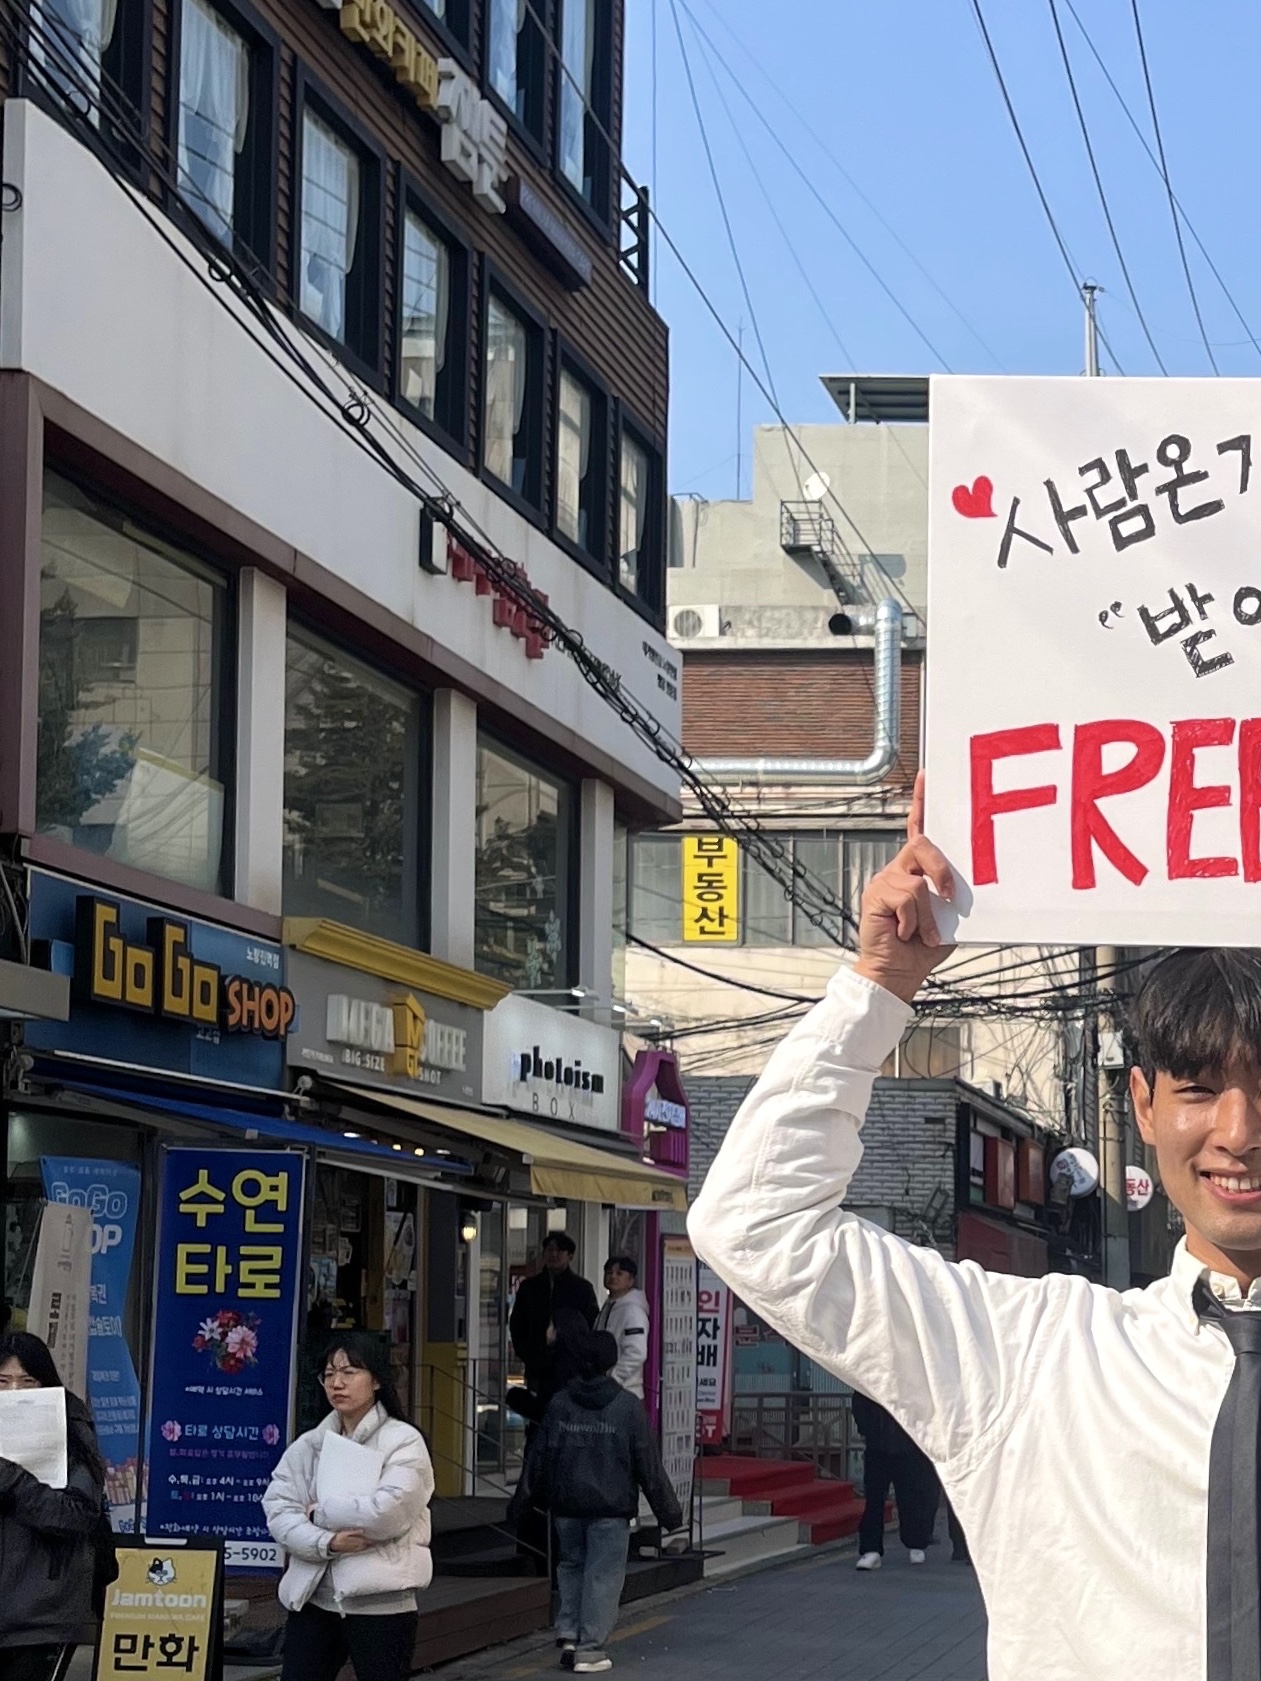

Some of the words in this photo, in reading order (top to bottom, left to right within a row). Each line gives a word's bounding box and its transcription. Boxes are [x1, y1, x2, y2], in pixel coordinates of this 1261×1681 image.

[693, 836, 729, 936] 부동산
[226, 978, 294, 1036] SHOP
[178, 1168, 289, 1233] 수연
[1126, 1178, 1150, 1197] 동산
[175, 1242, 283, 1299] 타로
[211, 1424, 260, 1441] 상담시간
[113, 1632, 200, 1673] 만화
